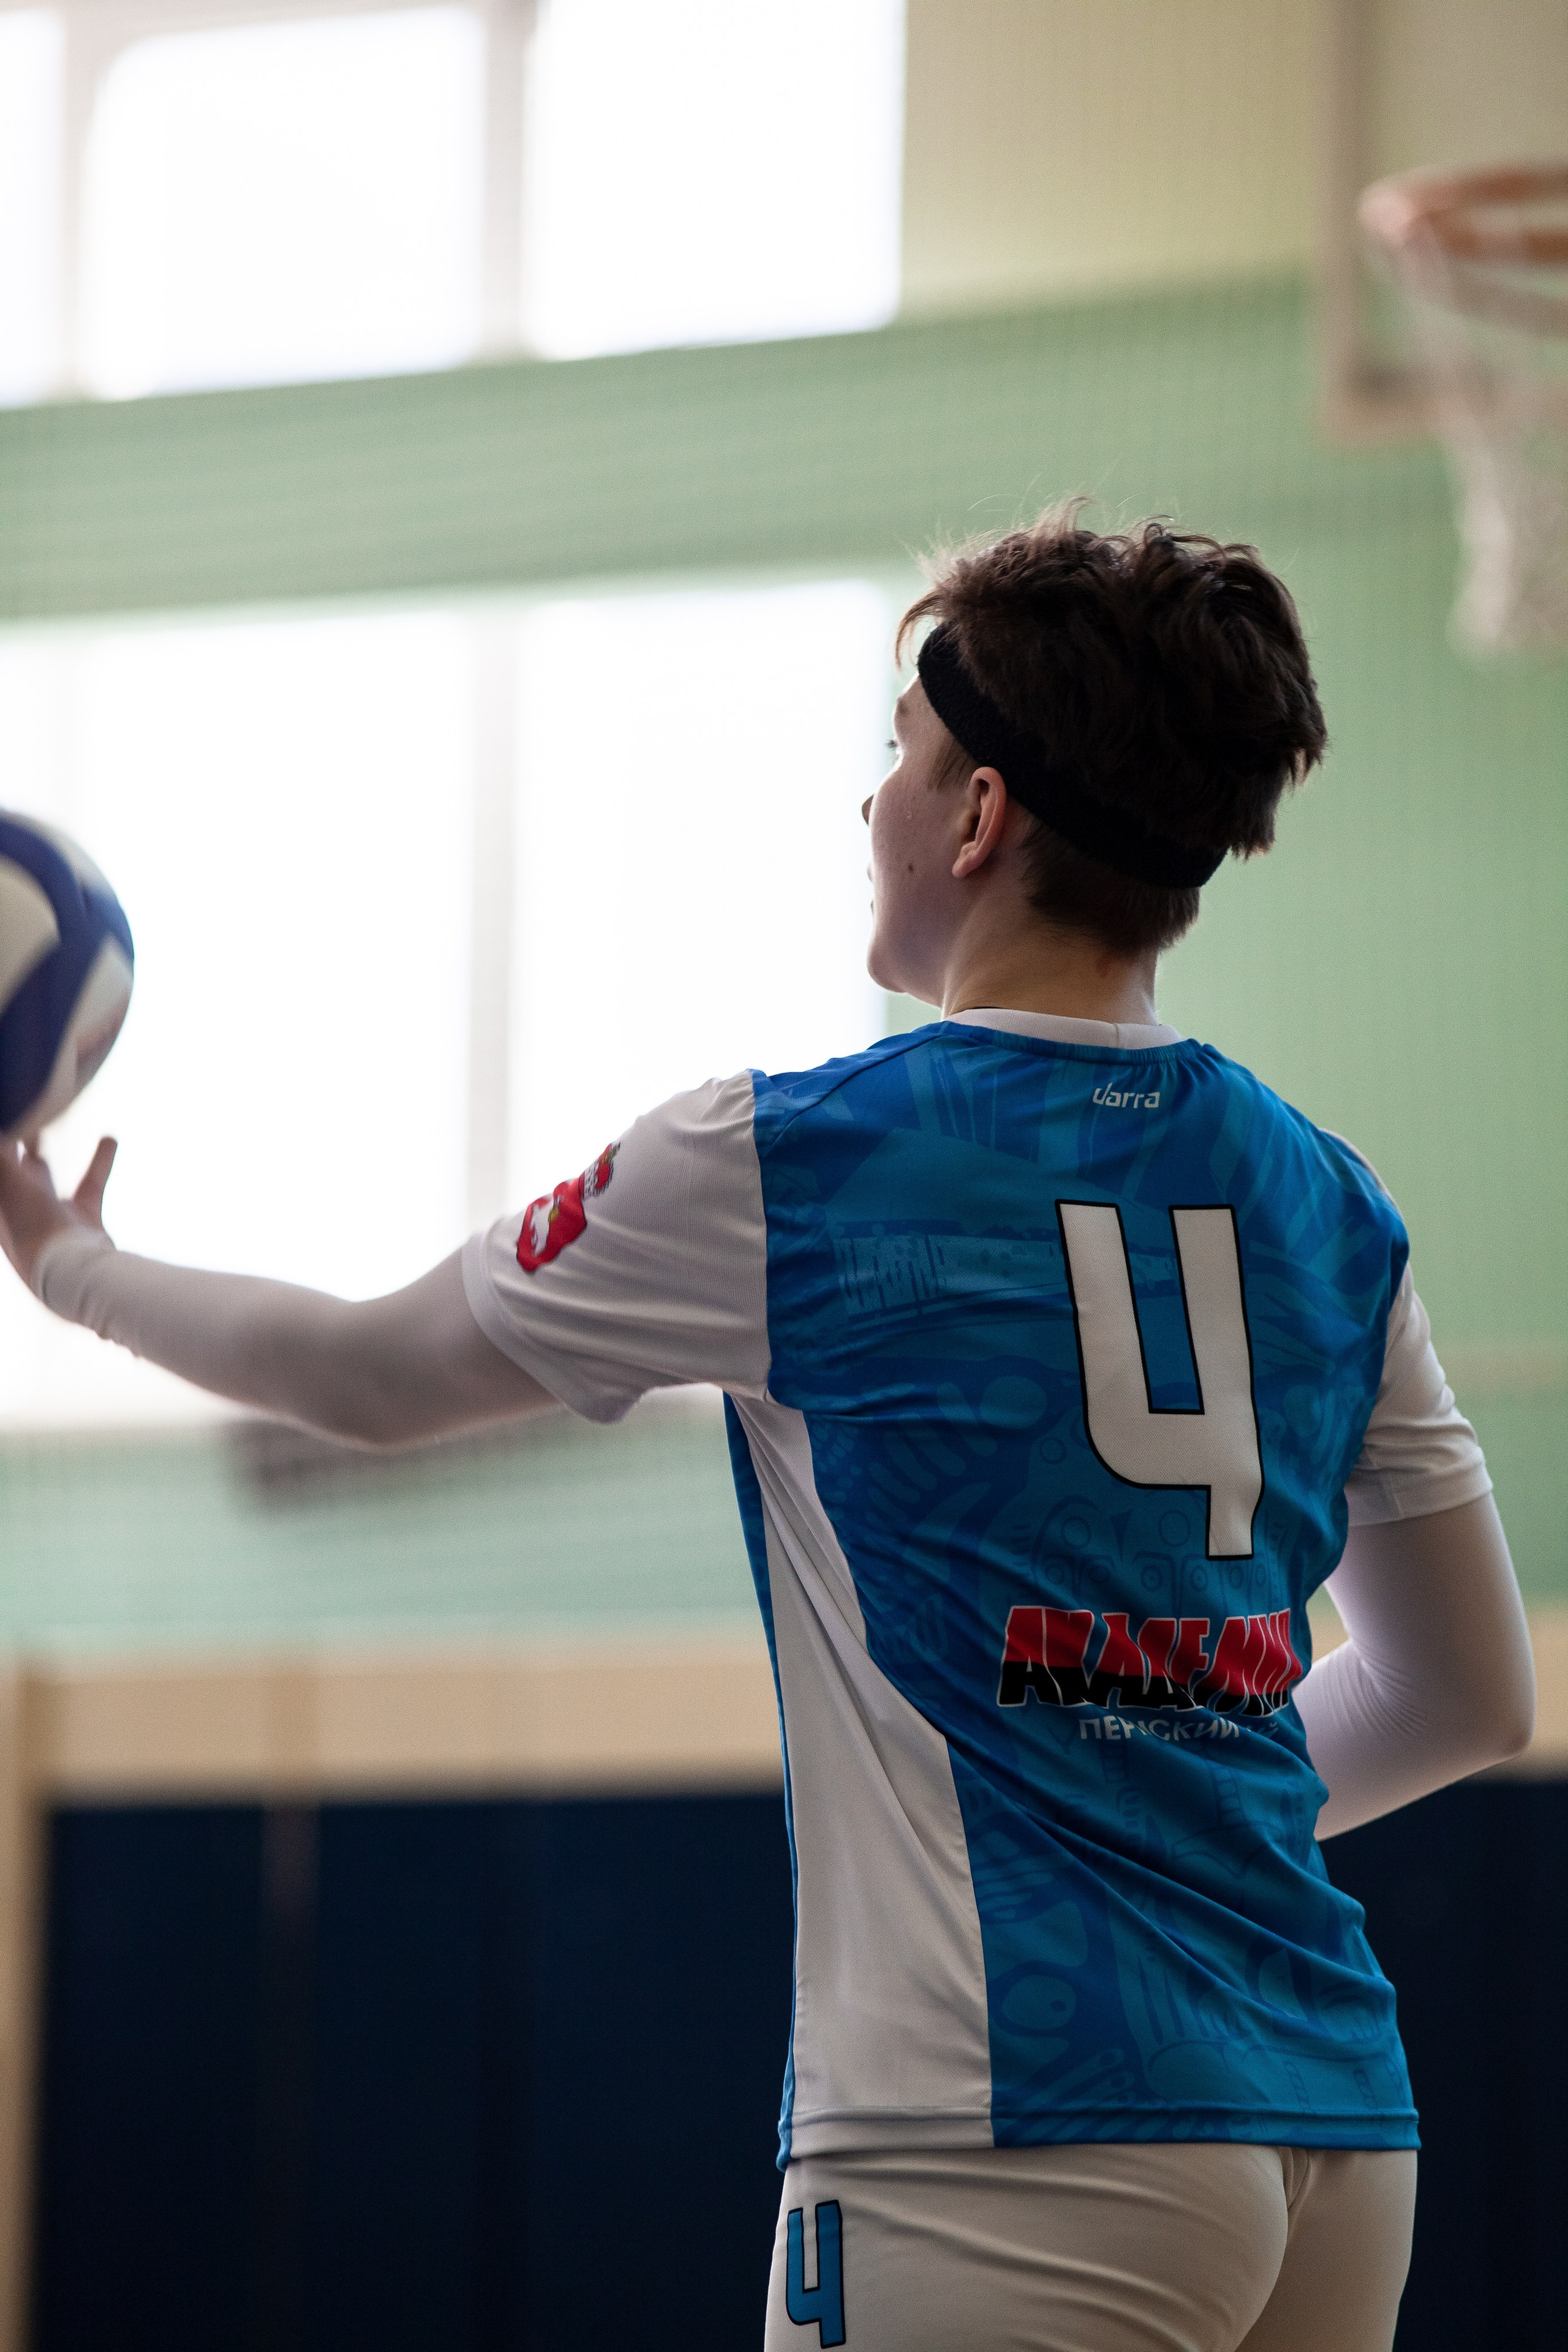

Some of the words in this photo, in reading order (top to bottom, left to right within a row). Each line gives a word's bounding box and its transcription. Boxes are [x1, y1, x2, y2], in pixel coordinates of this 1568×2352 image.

[1093, 1082, 1160, 1109] darra
[1055, 1199, 1265, 1561] 4
[785, 2199, 846, 2350] 4
